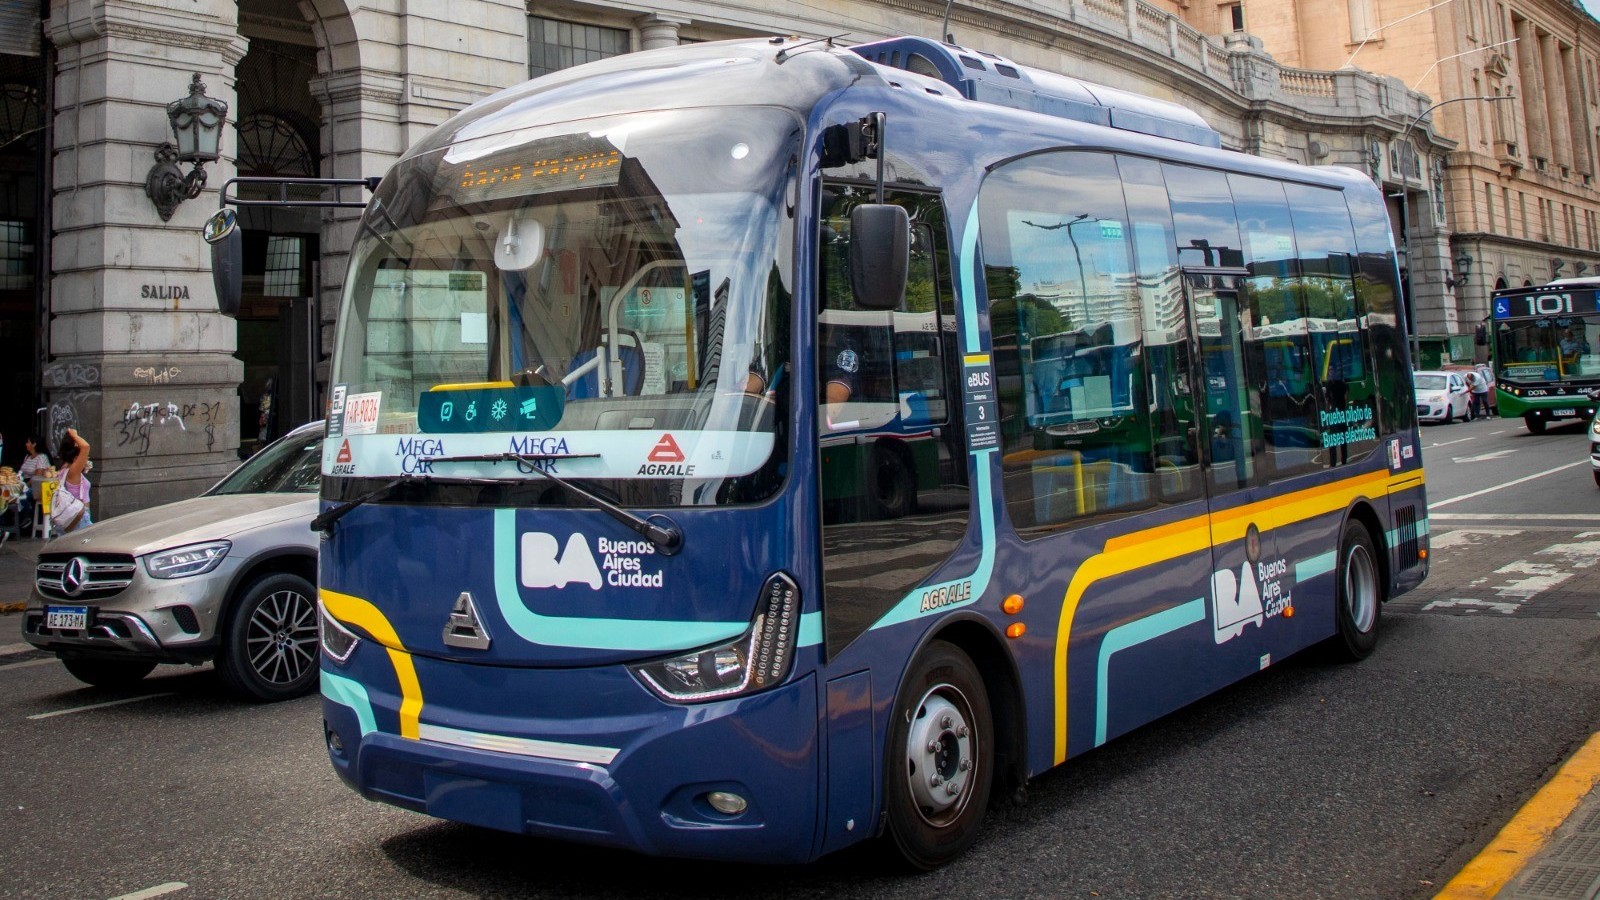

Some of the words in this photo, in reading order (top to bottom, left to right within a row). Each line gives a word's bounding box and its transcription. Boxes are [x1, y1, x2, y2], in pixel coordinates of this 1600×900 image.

[141, 284, 190, 300] SALIDA
[1525, 294, 1574, 316] 101
[967, 372, 990, 387] eBUS
[978, 405, 985, 420] 3
[1320, 408, 1345, 427] Prueba
[1345, 405, 1364, 426] piloto
[1364, 404, 1372, 420] de
[395, 437, 445, 456] MEGA
[508, 435, 570, 455] MEGA
[1322, 431, 1345, 449] Buses
[1344, 425, 1376, 444] eléctricos
[331, 464, 356, 475] AGRALE
[402, 453, 435, 474] CAR
[516, 456, 559, 474] CAR
[637, 464, 696, 476] AGRALE
[598, 537, 656, 555] Buenos
[521, 532, 603, 591] BA
[602, 553, 641, 571] Aires
[1258, 557, 1287, 582] Buenos
[607, 570, 663, 588] Ciudad
[920, 581, 972, 613] AGRALE
[1262, 578, 1281, 601] Aires
[1265, 590, 1292, 619] Ciudad
[60, 614, 73, 627] 173
